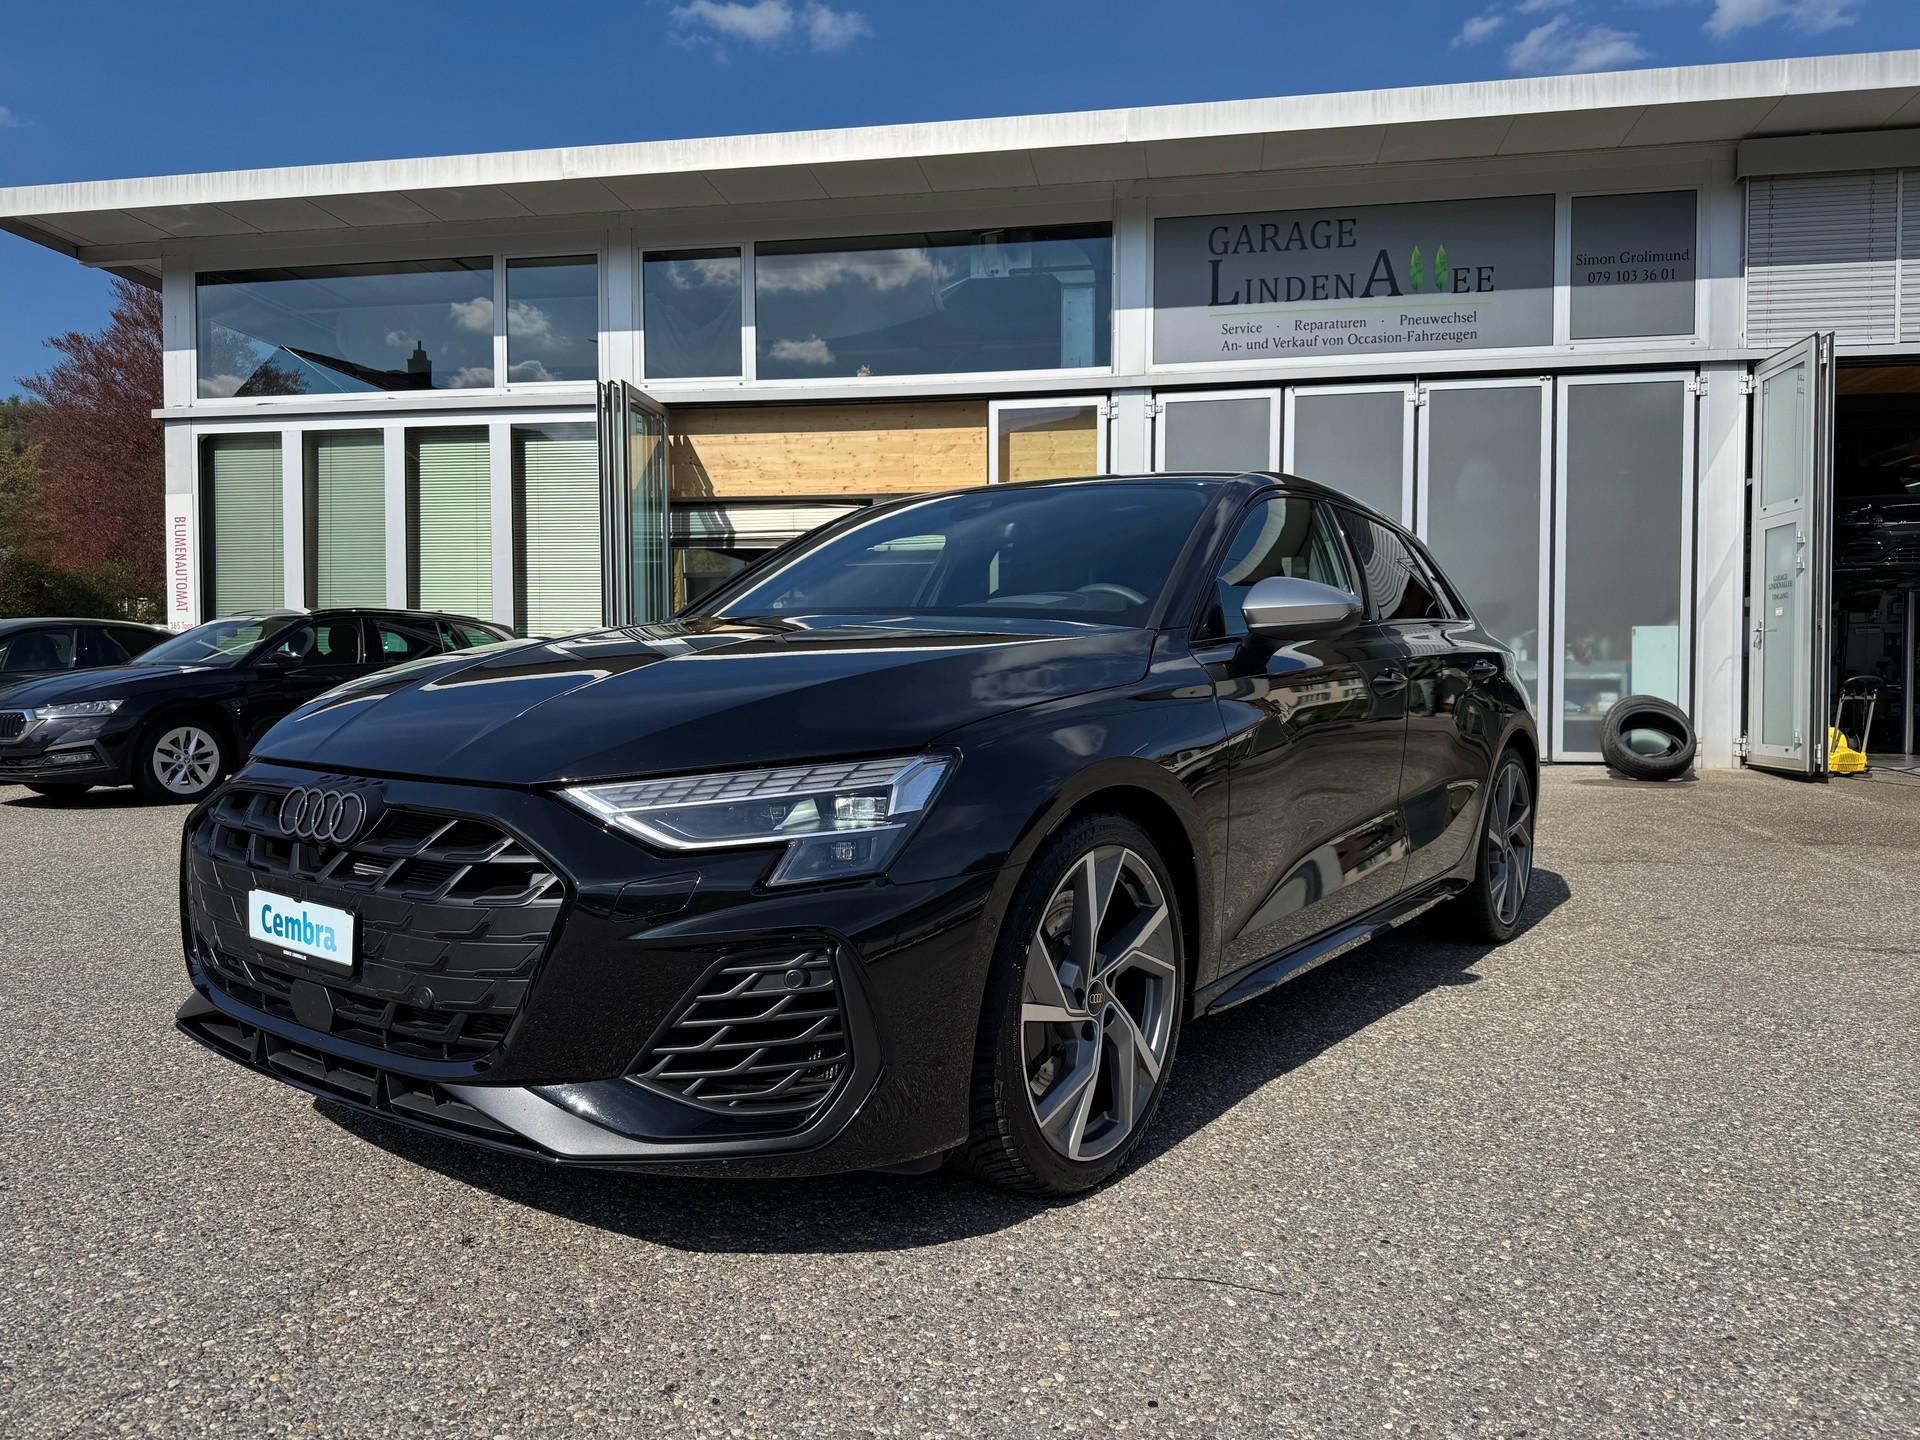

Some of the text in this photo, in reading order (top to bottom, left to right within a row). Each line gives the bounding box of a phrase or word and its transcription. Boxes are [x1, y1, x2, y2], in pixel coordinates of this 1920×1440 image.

[1208, 218, 1357, 255] GARAGE
[1576, 248, 1690, 266] Simon Grolimund
[1588, 268, 1675, 283] 079 103 36 01
[1221, 311, 1477, 335] Service Reparaturen Pneuwechsel
[1221, 330, 1478, 351] An- und Verkauf von Occasion-Fahrzeugen
[174, 516, 188, 612] BLUMENAUTOMAT
[261, 904, 337, 952] Cembra
